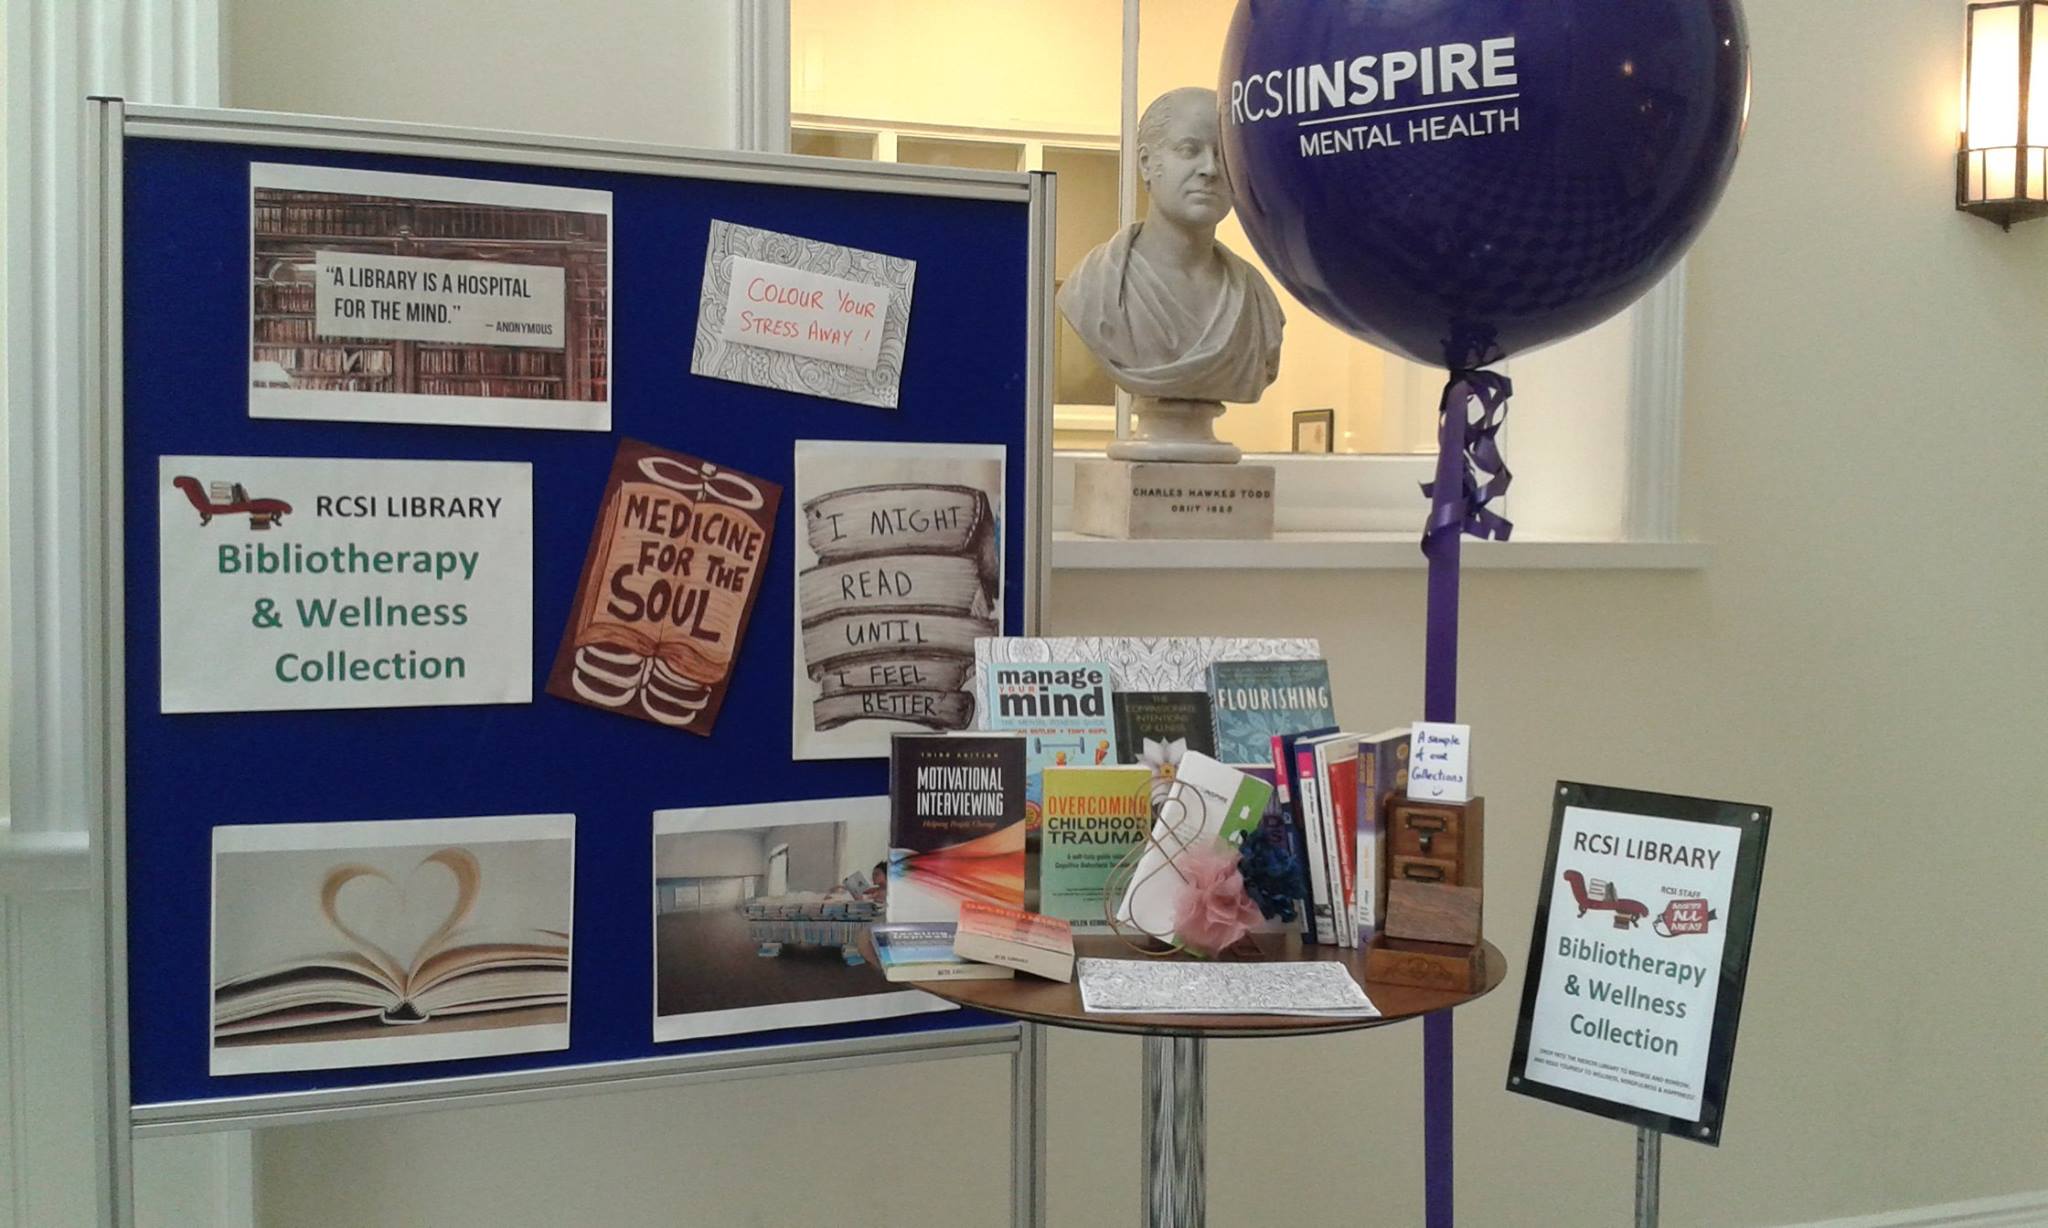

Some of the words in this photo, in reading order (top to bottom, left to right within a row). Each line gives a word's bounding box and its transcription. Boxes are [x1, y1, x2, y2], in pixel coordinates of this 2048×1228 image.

[1231, 68, 1292, 126] RCSI
[1296, 36, 1518, 114] INSPIRE
[1300, 123, 1401, 158] MENTAL
[1408, 107, 1520, 144] HEALTH
[350, 268, 419, 291] LIBRARY
[423, 272, 437, 292] IS
[442, 273, 452, 293] A
[457, 274, 531, 298] HOSPITAL
[747, 277, 824, 310] COLOUR
[838, 288, 876, 318] YOUR
[334, 298, 365, 319] FOR
[372, 300, 401, 321] THE
[740, 311, 799, 338] STRESS
[496, 322, 553, 335] ANONYMOUS
[316, 495, 376, 518] RCSI
[387, 496, 502, 518] LIBRARY
[1133, 488, 1183, 498] CHARLES
[1188, 489, 1236, 499] HAWKES
[623, 493, 762, 562] MEDICINE
[827, 513, 847, 541] I
[870, 506, 961, 536] MIGHT
[218, 543, 479, 580] Bibliotherapy
[637, 540, 695, 577] FOR
[705, 554, 749, 593] THE
[841, 569, 912, 600] READ
[251, 598, 283, 628] &
[296, 596, 468, 628] Wellness
[607, 563, 721, 643] SOUL
[846, 619, 928, 645] UNTIL
[275, 650, 466, 683] Collection
[832, 669, 850, 688] I
[870, 665, 927, 685] FEEL
[997, 667, 1103, 689] manage
[862, 692, 937, 716] BETTER
[999, 686, 1036, 694] YOUR
[1000, 686, 1105, 717] mind
[1218, 686, 1328, 711] FLOURISHING
[1417, 731, 1425, 744] A
[1427, 734, 1460, 746] sample
[917, 766, 1004, 791] MOTIVATIONAL
[917, 792, 1003, 816] INTERVIEWING
[1048, 795, 1147, 816] OVERCOMING
[1048, 831, 1145, 845] TRAUMA
[1573, 831, 1619, 857] RCSI
[1625, 838, 1721, 871] LIBRARY
[1558, 935, 1707, 988] Bibliotherapy
[1564, 974, 1581, 997] &
[1588, 978, 1687, 1020] Wellness
[1570, 1013, 1679, 1057] Collection
